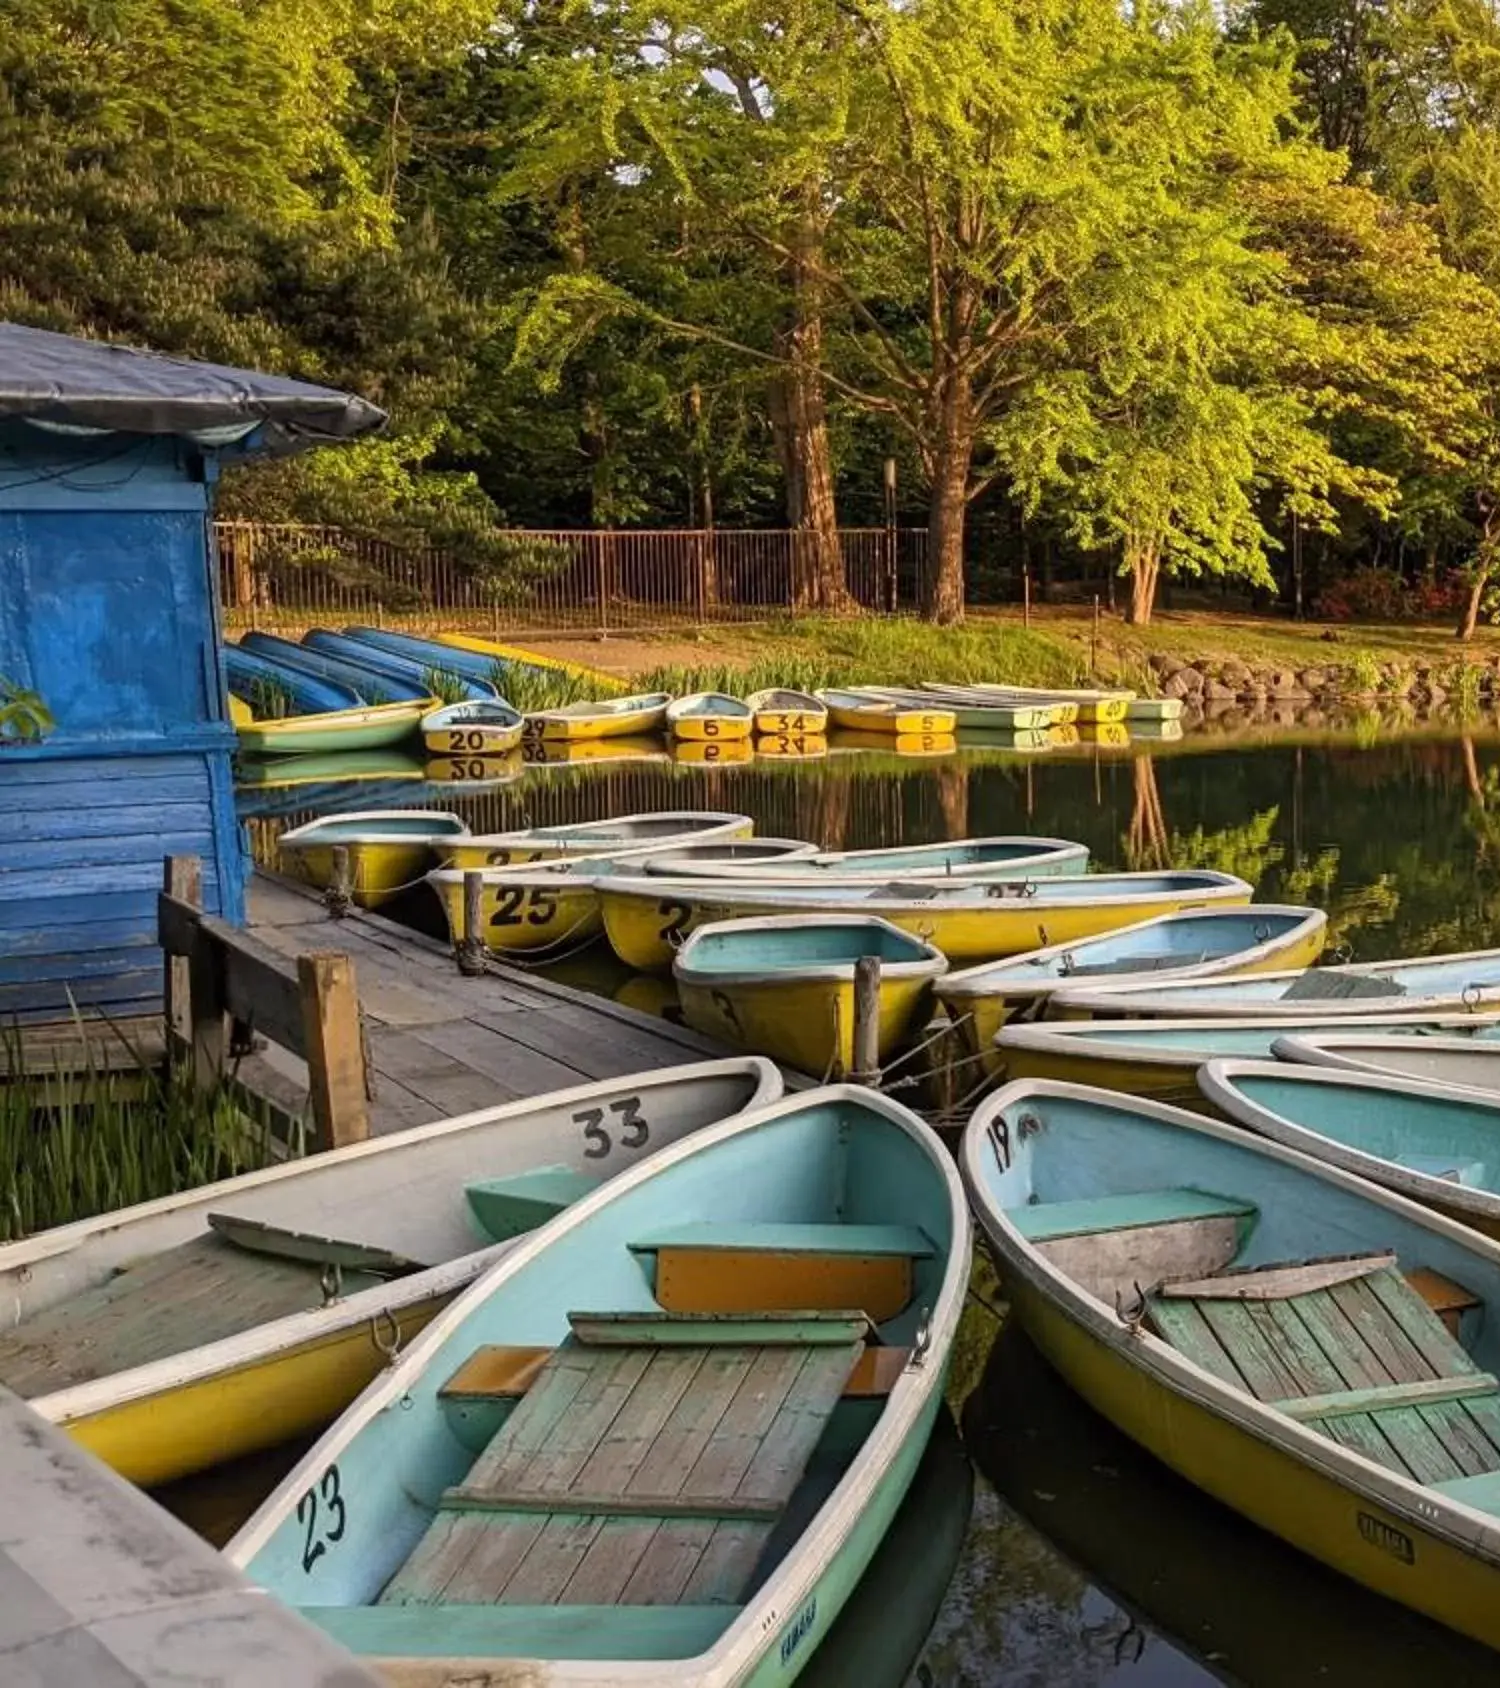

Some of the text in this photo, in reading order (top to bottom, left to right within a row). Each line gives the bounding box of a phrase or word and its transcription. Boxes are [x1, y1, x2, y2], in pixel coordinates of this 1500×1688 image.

[449, 731, 484, 751] 20
[778, 713, 805, 731] 34
[490, 886, 560, 926] 25
[572, 1096, 648, 1159] 33
[986, 1114, 1010, 1175] 19
[297, 1463, 346, 1574] 23
